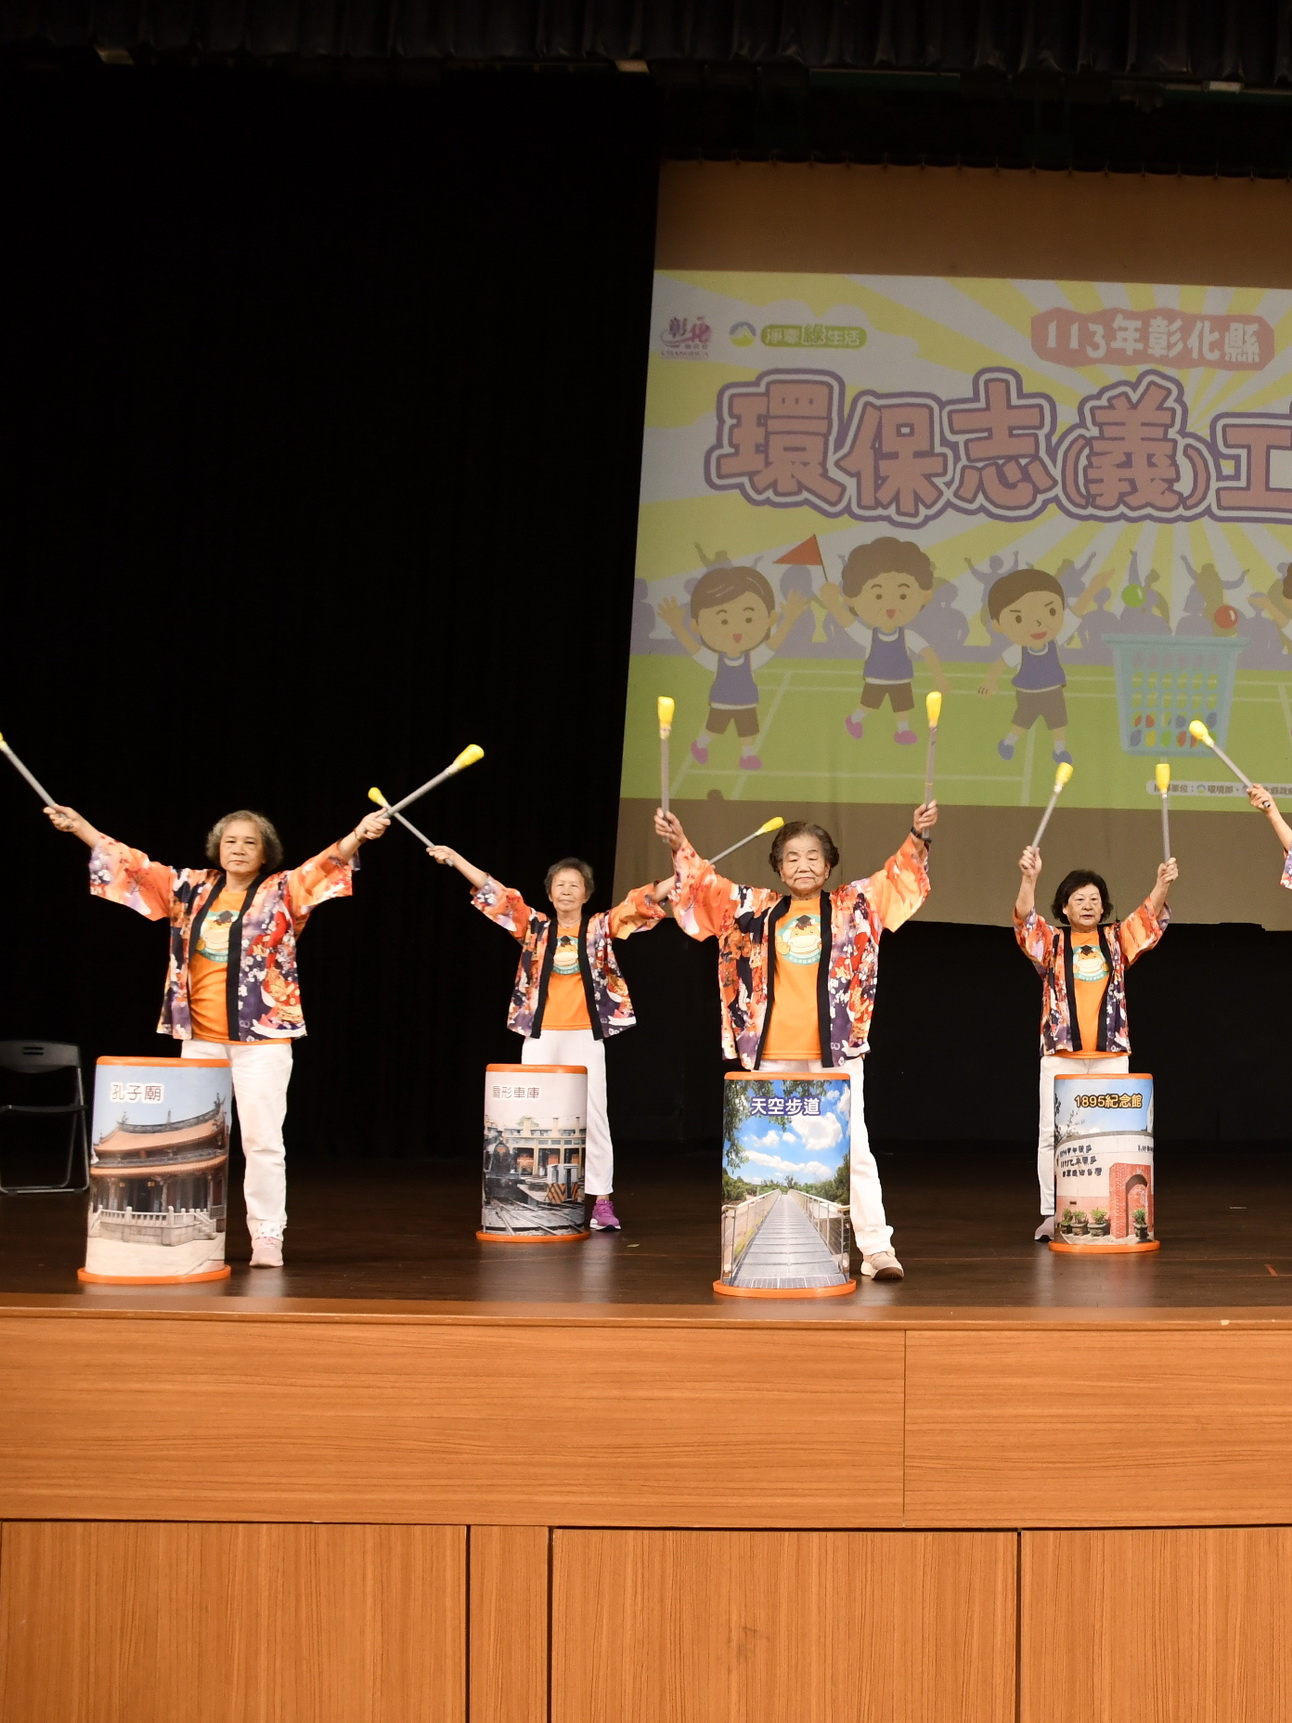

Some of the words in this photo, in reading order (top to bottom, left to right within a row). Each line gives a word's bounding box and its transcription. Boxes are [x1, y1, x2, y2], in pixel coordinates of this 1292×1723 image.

[1046, 312, 1261, 364] 113年彰化縣
[111, 1084, 162, 1102] 孔子廟
[492, 1085, 540, 1099] 扇形車庫
[1074, 1093, 1143, 1109] 1895紀念館
[750, 1097, 821, 1115] 天空步道
